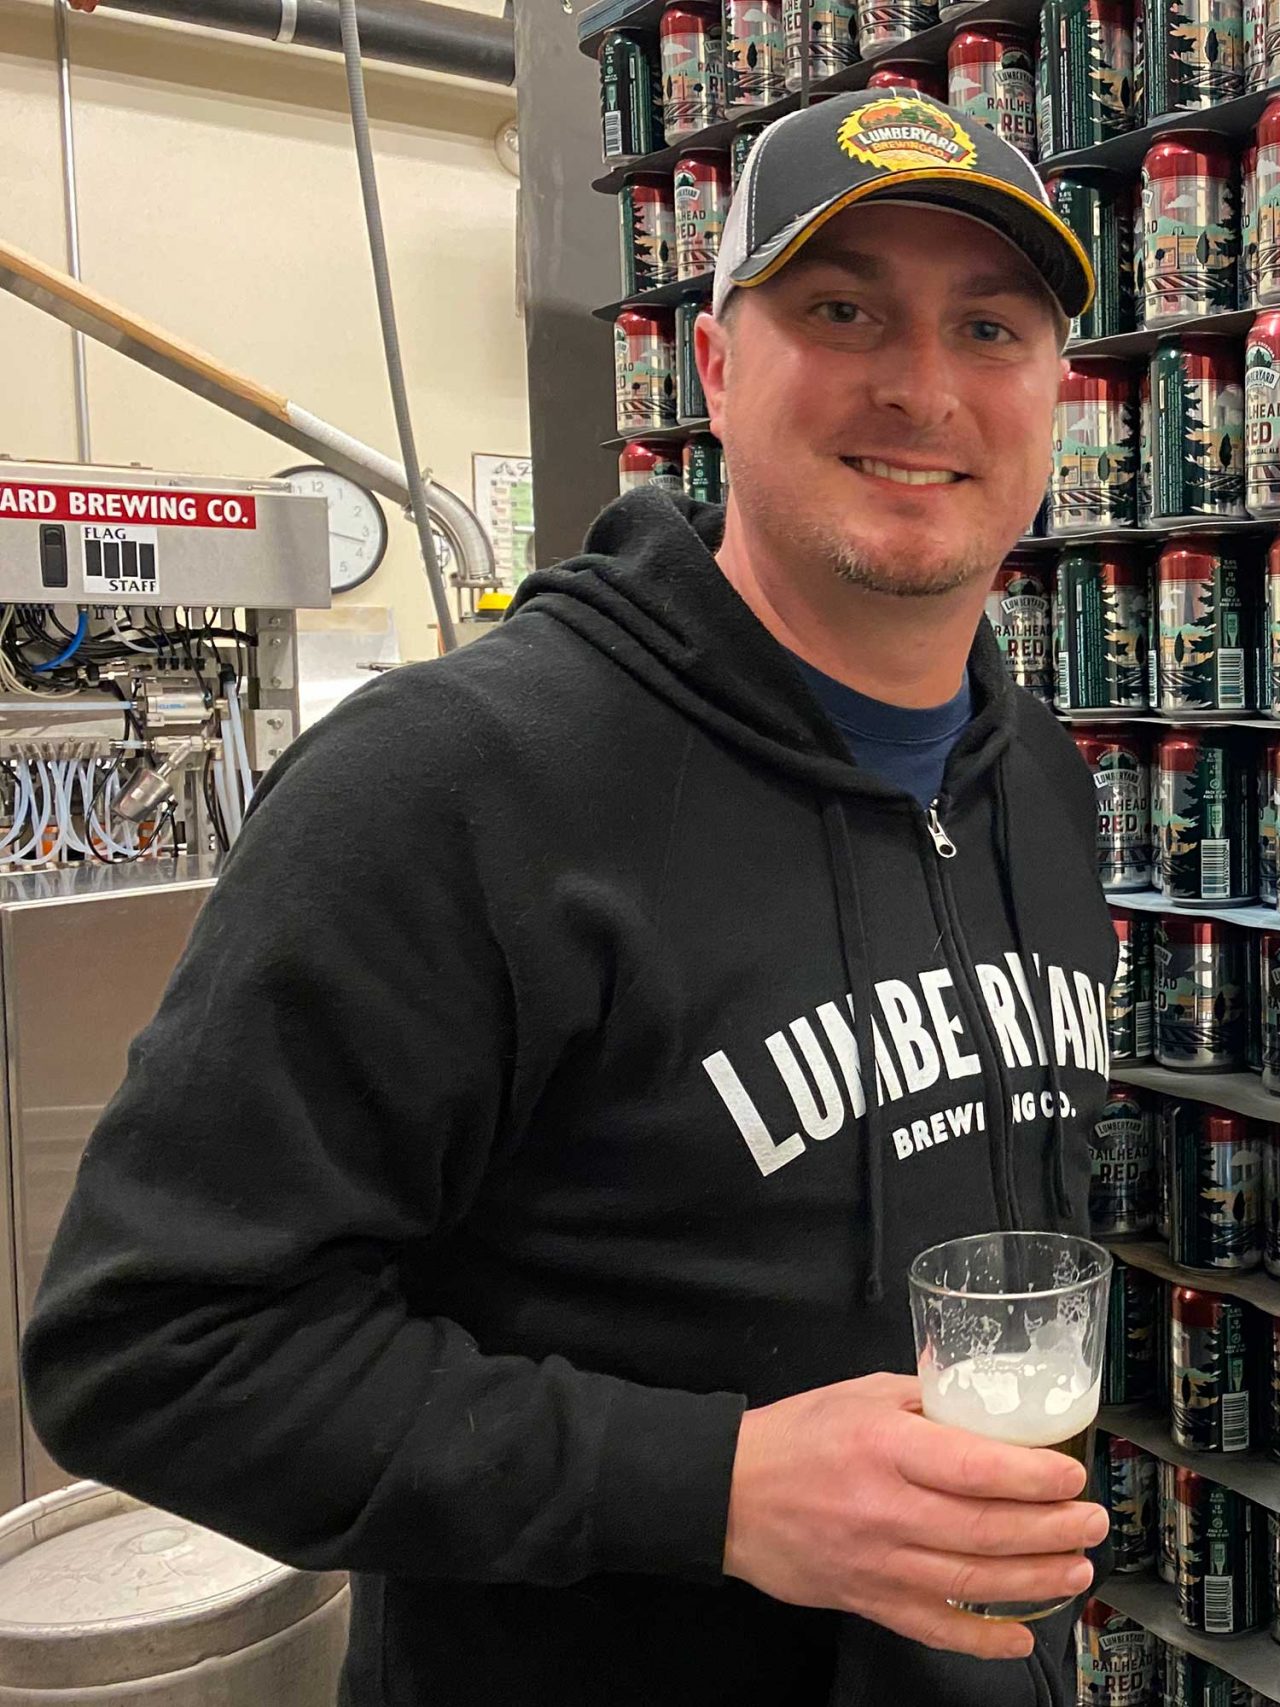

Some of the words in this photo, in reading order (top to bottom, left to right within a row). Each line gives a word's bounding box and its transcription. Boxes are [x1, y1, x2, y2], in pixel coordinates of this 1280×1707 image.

[698, 61, 722, 75] RAIL
[987, 98, 1035, 114] RAILHEA
[1002, 113, 1035, 136] RED
[857, 126, 960, 154] LUMBERYARD
[311, 480, 324, 493] 12
[68, 491, 197, 520] BREWING
[207, 499, 249, 523] CO.
[354, 506, 362, 517] 2
[84, 527, 127, 540] FLAG
[362, 525, 370, 537] 3
[355, 548, 364, 558] 4
[339, 561, 348, 573] 5
[109, 580, 157, 593] STAFF
[1007, 639, 1044, 658] RED
[1099, 814, 1138, 833] RED
[702, 952, 1110, 1177] LUMBERYAR
[892, 1093, 1034, 1161] BREWING
[1096, 1119, 1142, 1136] LUMBERYARD
[1101, 1162, 1140, 1183] RED
[1104, 1672, 1143, 1693] RED
